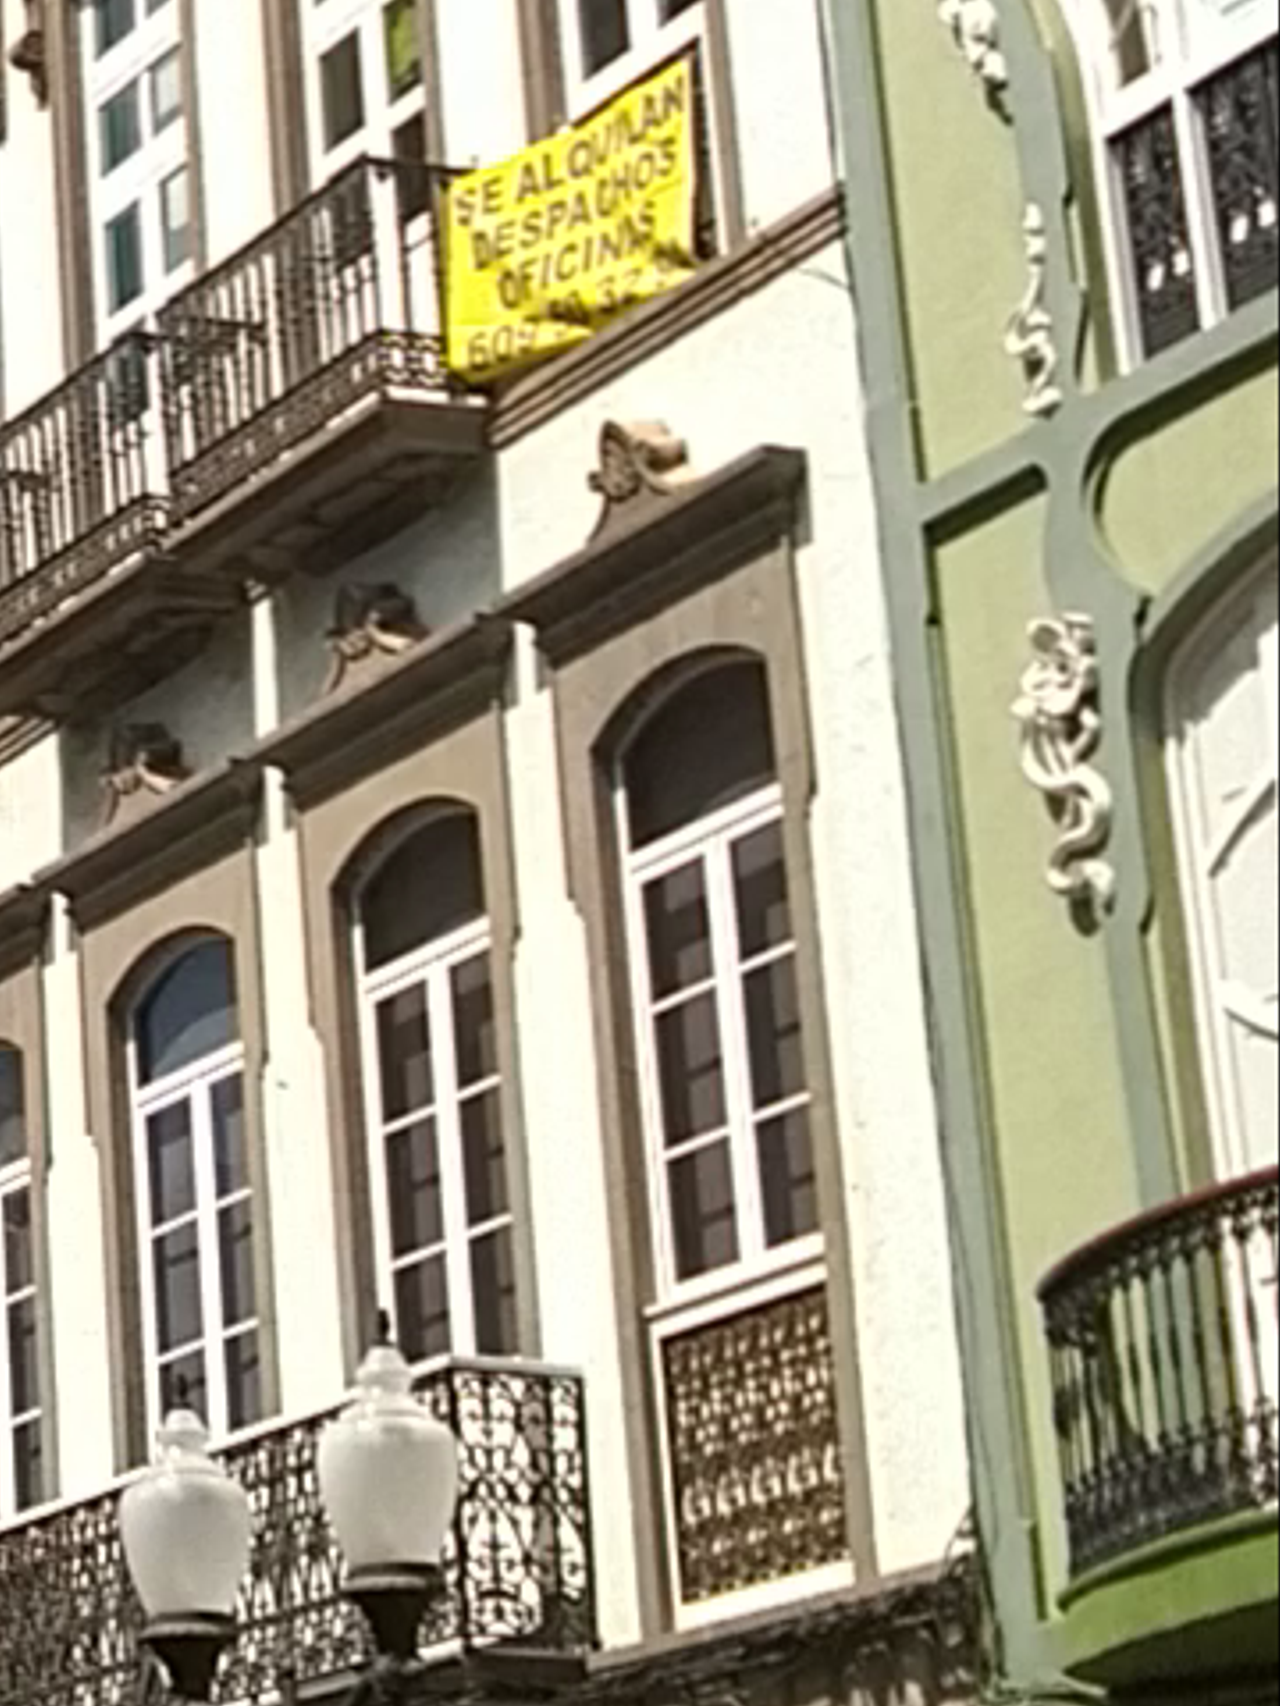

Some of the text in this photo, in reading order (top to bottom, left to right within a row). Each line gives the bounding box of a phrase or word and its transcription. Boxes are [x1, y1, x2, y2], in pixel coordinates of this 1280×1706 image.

[455, 76, 686, 224] SE ALQUILAN
[471, 136, 677, 270] DESPACHOS
[496, 199, 656, 308] OFICINAS
